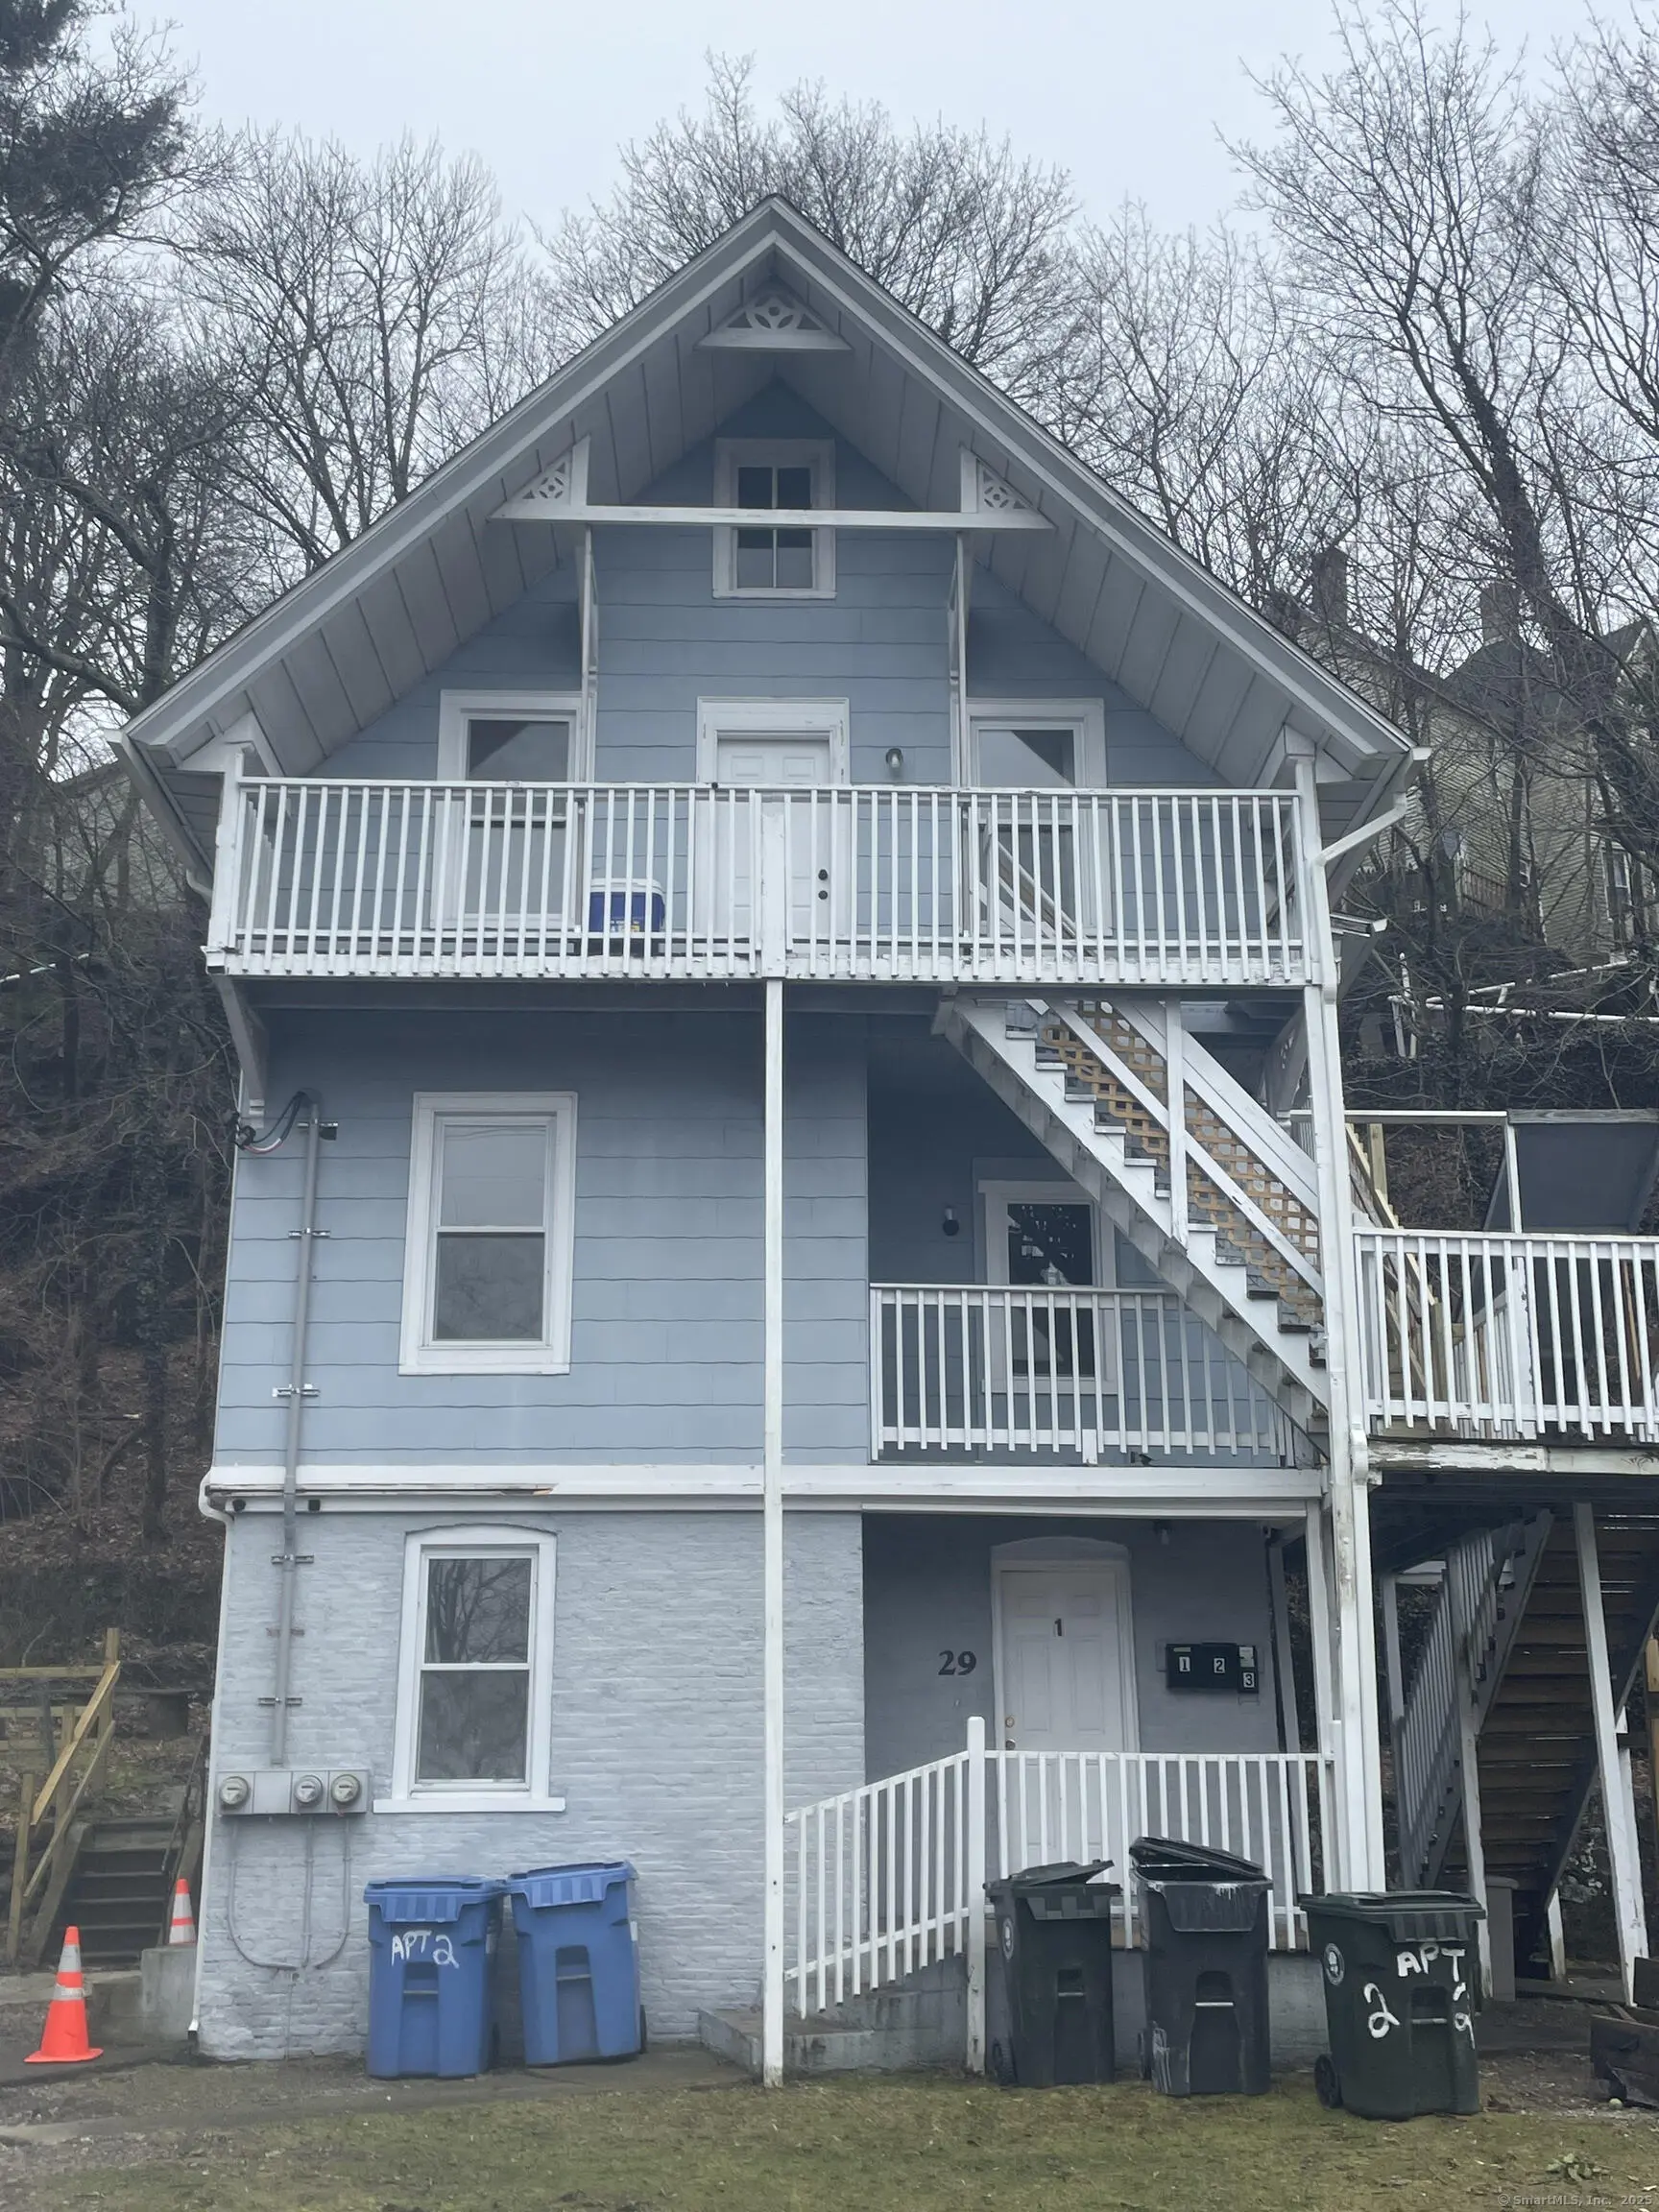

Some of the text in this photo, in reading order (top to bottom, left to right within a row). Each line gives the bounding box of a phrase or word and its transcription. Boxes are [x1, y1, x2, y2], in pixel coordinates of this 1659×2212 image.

[1054, 1618, 1063, 1637] 1
[938, 1649, 977, 1676] 29
[1181, 1658, 1189, 1671] 1
[1214, 1659, 1224, 1672] 2
[1244, 1673, 1254, 1687] 3
[391, 1930, 460, 1969] APT 2
[1397, 1942, 1466, 1982] APT
[1363, 1983, 1400, 2038] 2
